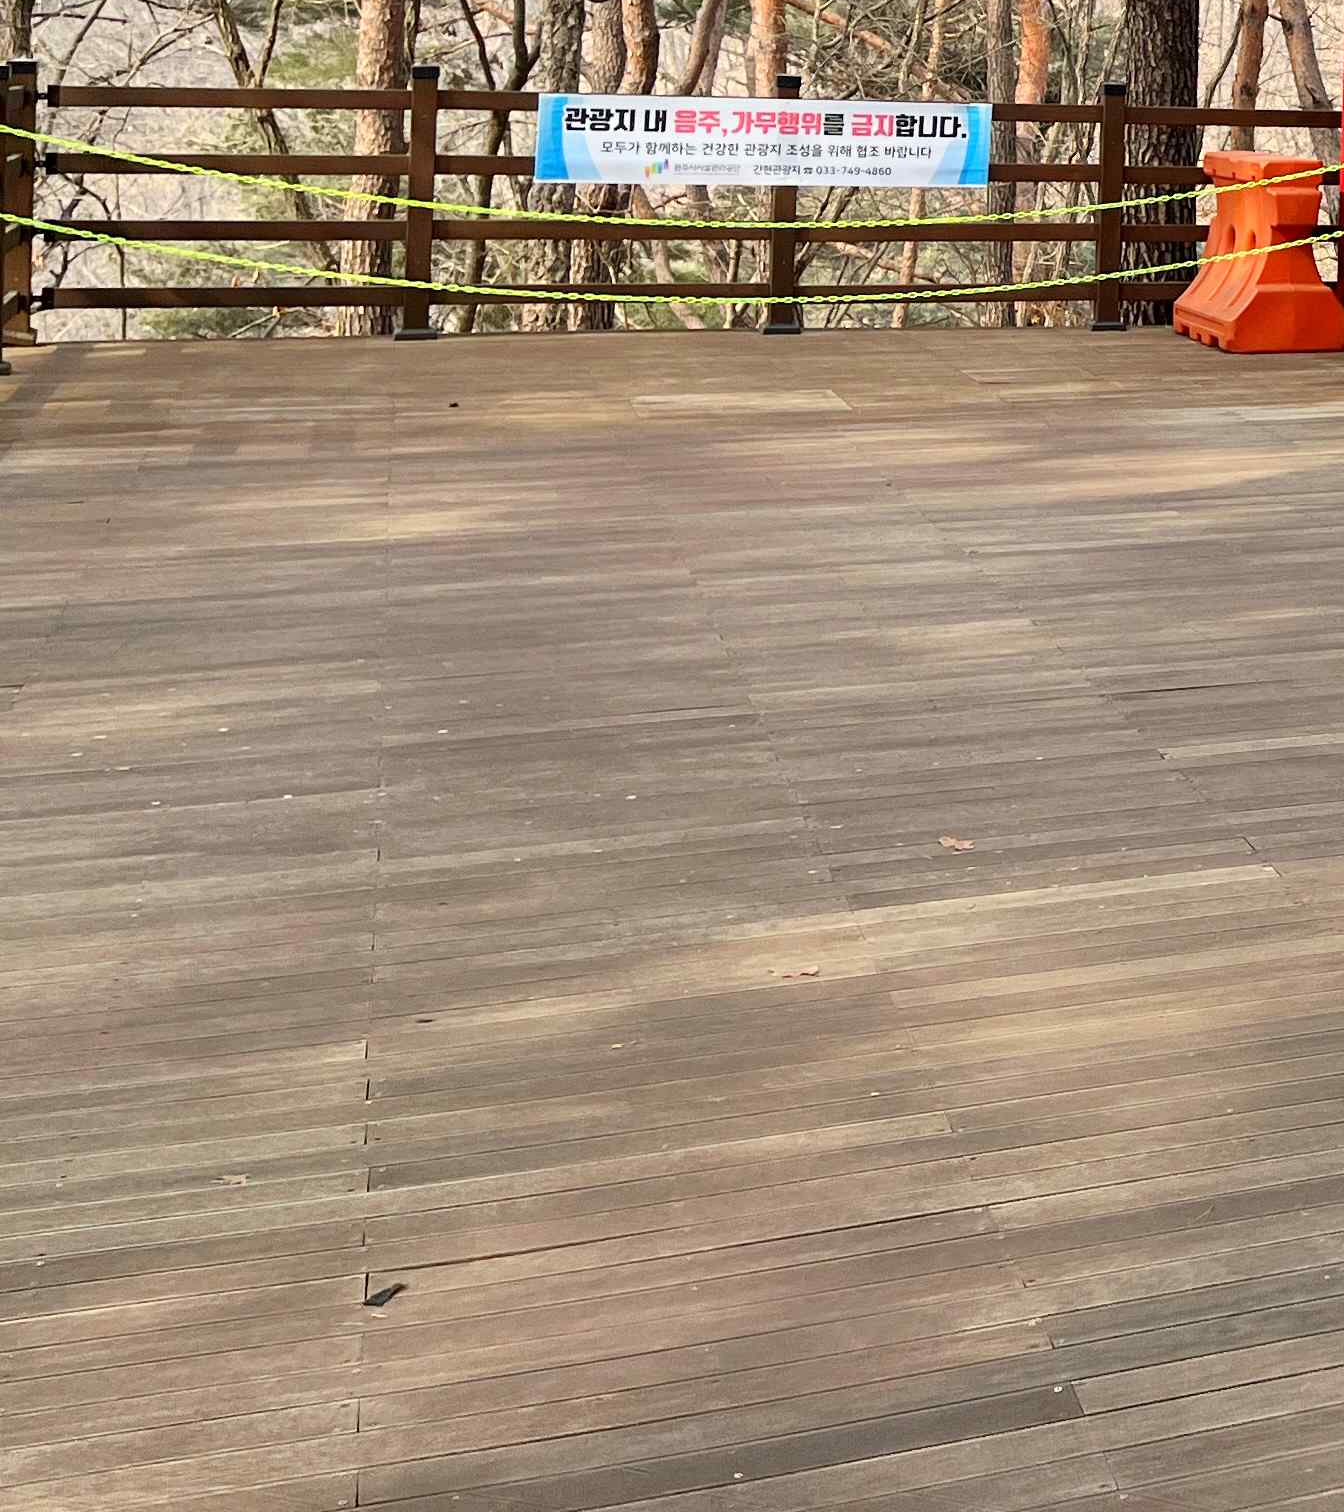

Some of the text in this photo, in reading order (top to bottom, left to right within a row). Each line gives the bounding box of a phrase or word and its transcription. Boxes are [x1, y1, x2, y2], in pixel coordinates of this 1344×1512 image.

[564, 107, 636, 133] 관광지
[643, 108, 668, 133] 내
[851, 113, 967, 139] 금지합니다.
[601, 141, 932, 159] 모두가 함께하는 건강한 관광지 조성을 위해 협조 바랍니다
